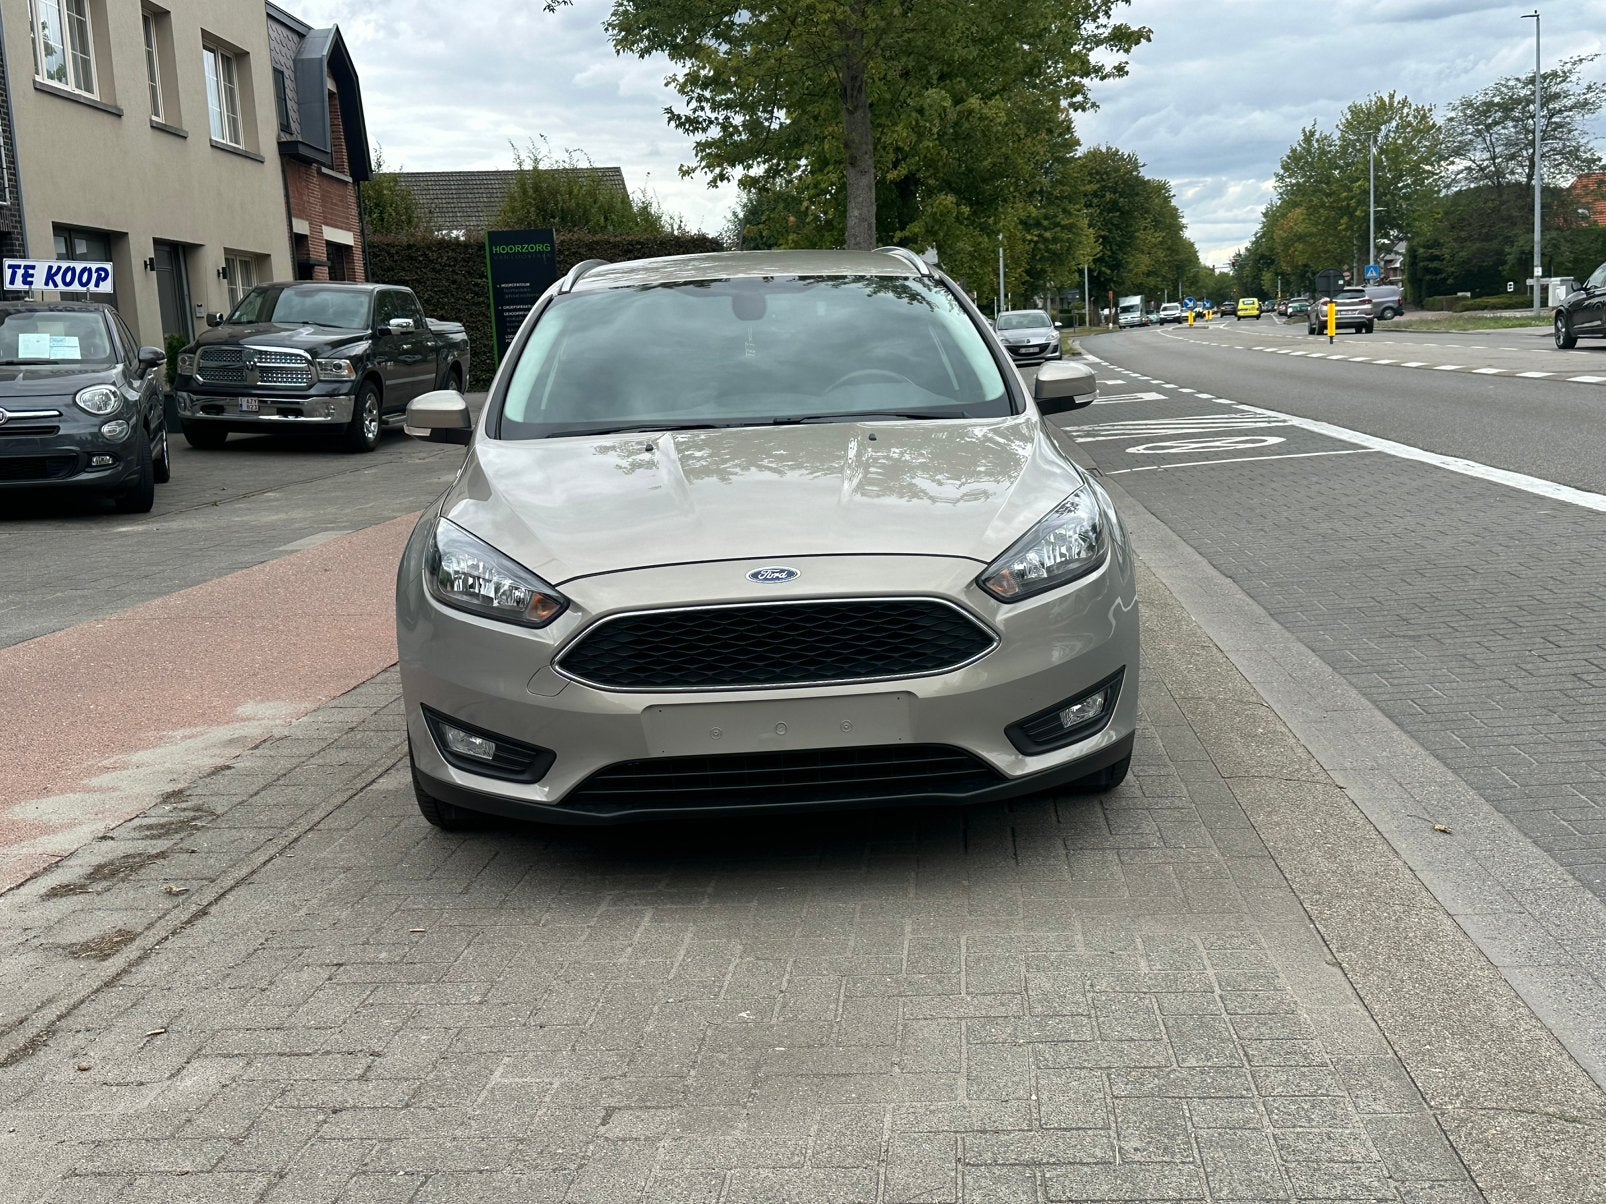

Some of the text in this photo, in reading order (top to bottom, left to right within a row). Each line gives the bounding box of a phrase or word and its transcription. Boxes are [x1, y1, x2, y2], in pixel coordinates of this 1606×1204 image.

[492, 243, 551, 253] HOORZORG
[7, 264, 110, 288] TE KOOP
[758, 569, 787, 579] Ford
